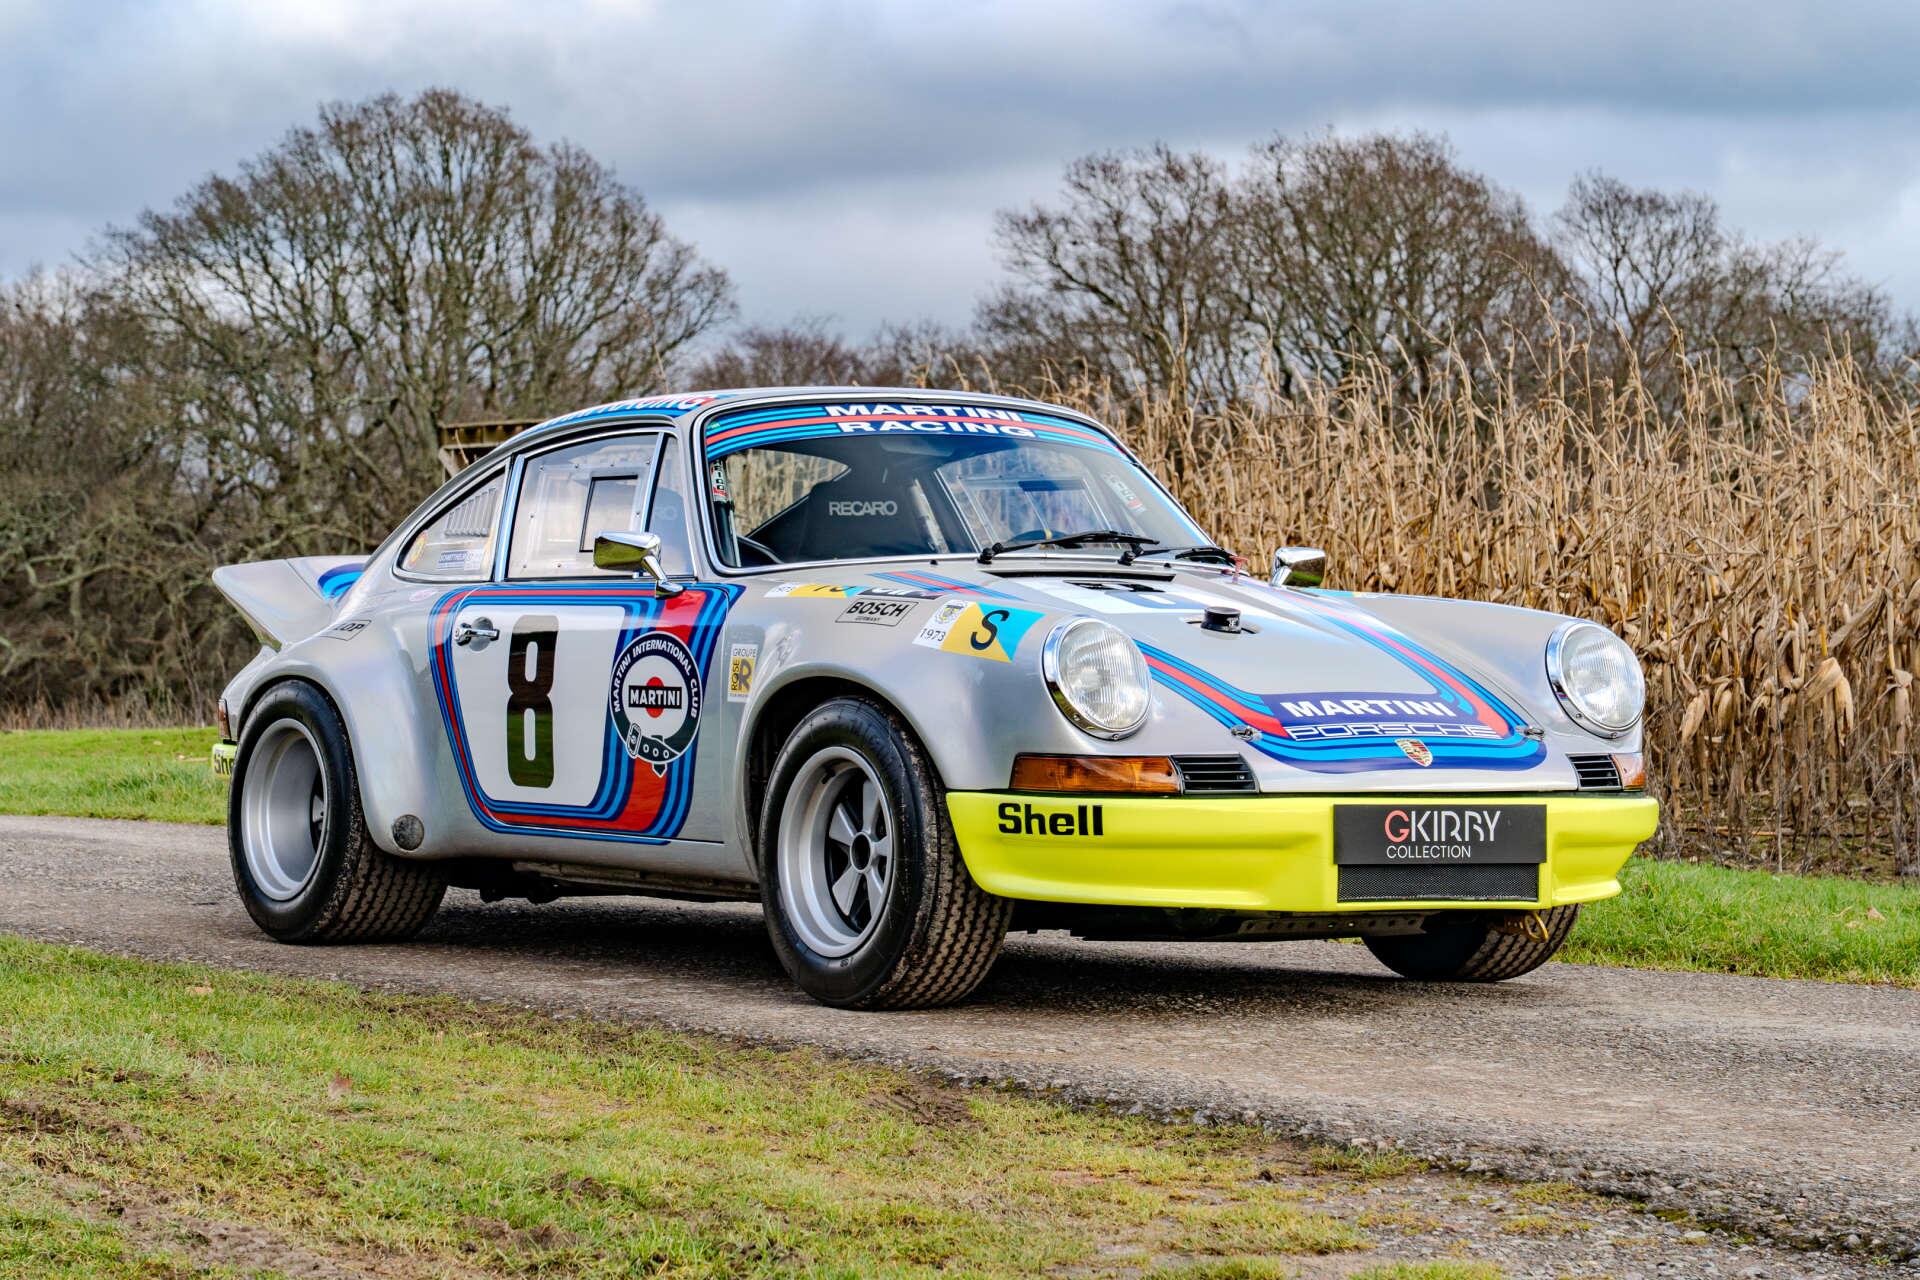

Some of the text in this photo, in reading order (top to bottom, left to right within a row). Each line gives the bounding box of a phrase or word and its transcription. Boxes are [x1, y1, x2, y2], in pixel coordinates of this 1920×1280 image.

[825, 405, 1024, 422] MARTINI
[838, 421, 1036, 438] RACING
[828, 500, 898, 516] RECARO
[847, 601, 909, 617] BOSCH
[920, 627, 947, 642] 1973
[970, 609, 1010, 650] S
[613, 639, 699, 719] MARTINI INTERNATIONAL CLUB
[507, 614, 560, 788] 8
[630, 688, 681, 706] MARTINI
[1280, 700, 1457, 719] MARTINI
[1285, 721, 1504, 741] PORSCHE
[998, 803, 1104, 836] Shell
[1386, 845, 1471, 859] COLLECTION
